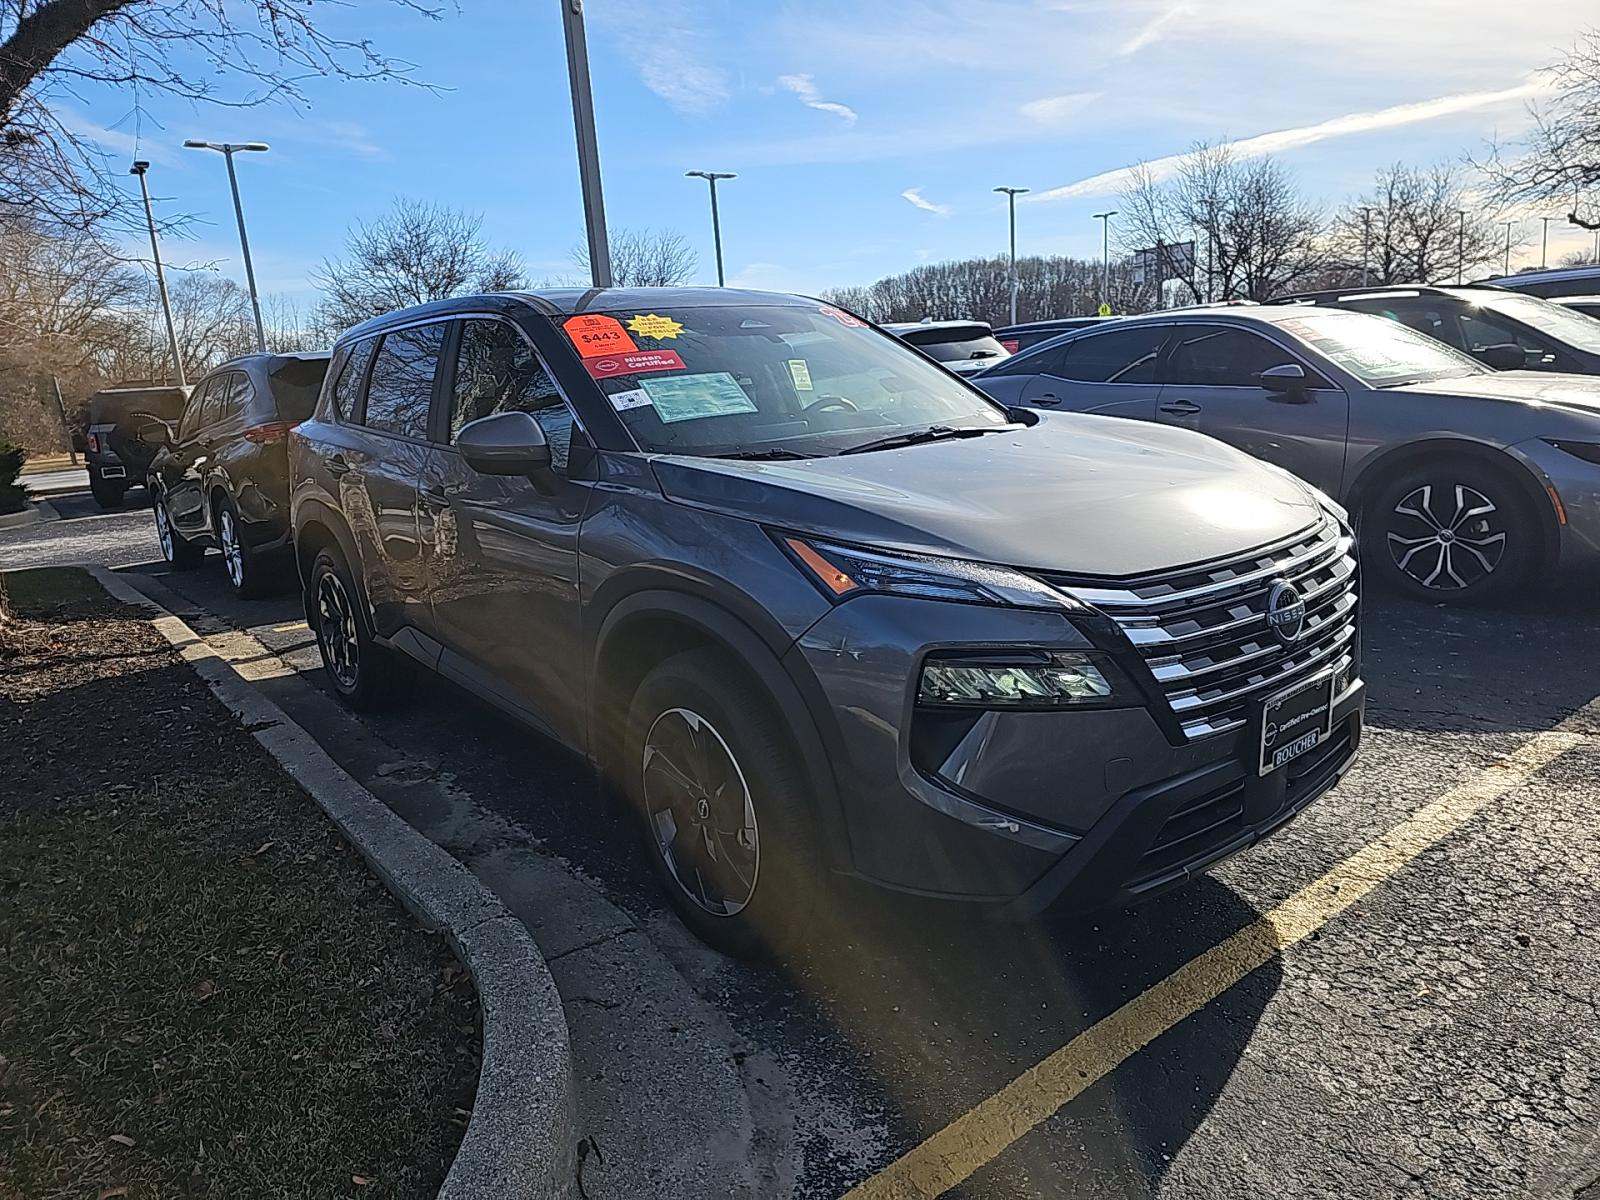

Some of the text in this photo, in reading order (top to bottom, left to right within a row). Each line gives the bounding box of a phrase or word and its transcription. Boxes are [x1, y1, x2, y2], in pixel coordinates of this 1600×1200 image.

[581, 331, 621, 344] $443
[624, 354, 662, 363] Nissan
[628, 359, 676, 368] Certified
[1280, 715, 1301, 732] Certified
[1276, 733, 1317, 765] BOUCHER
